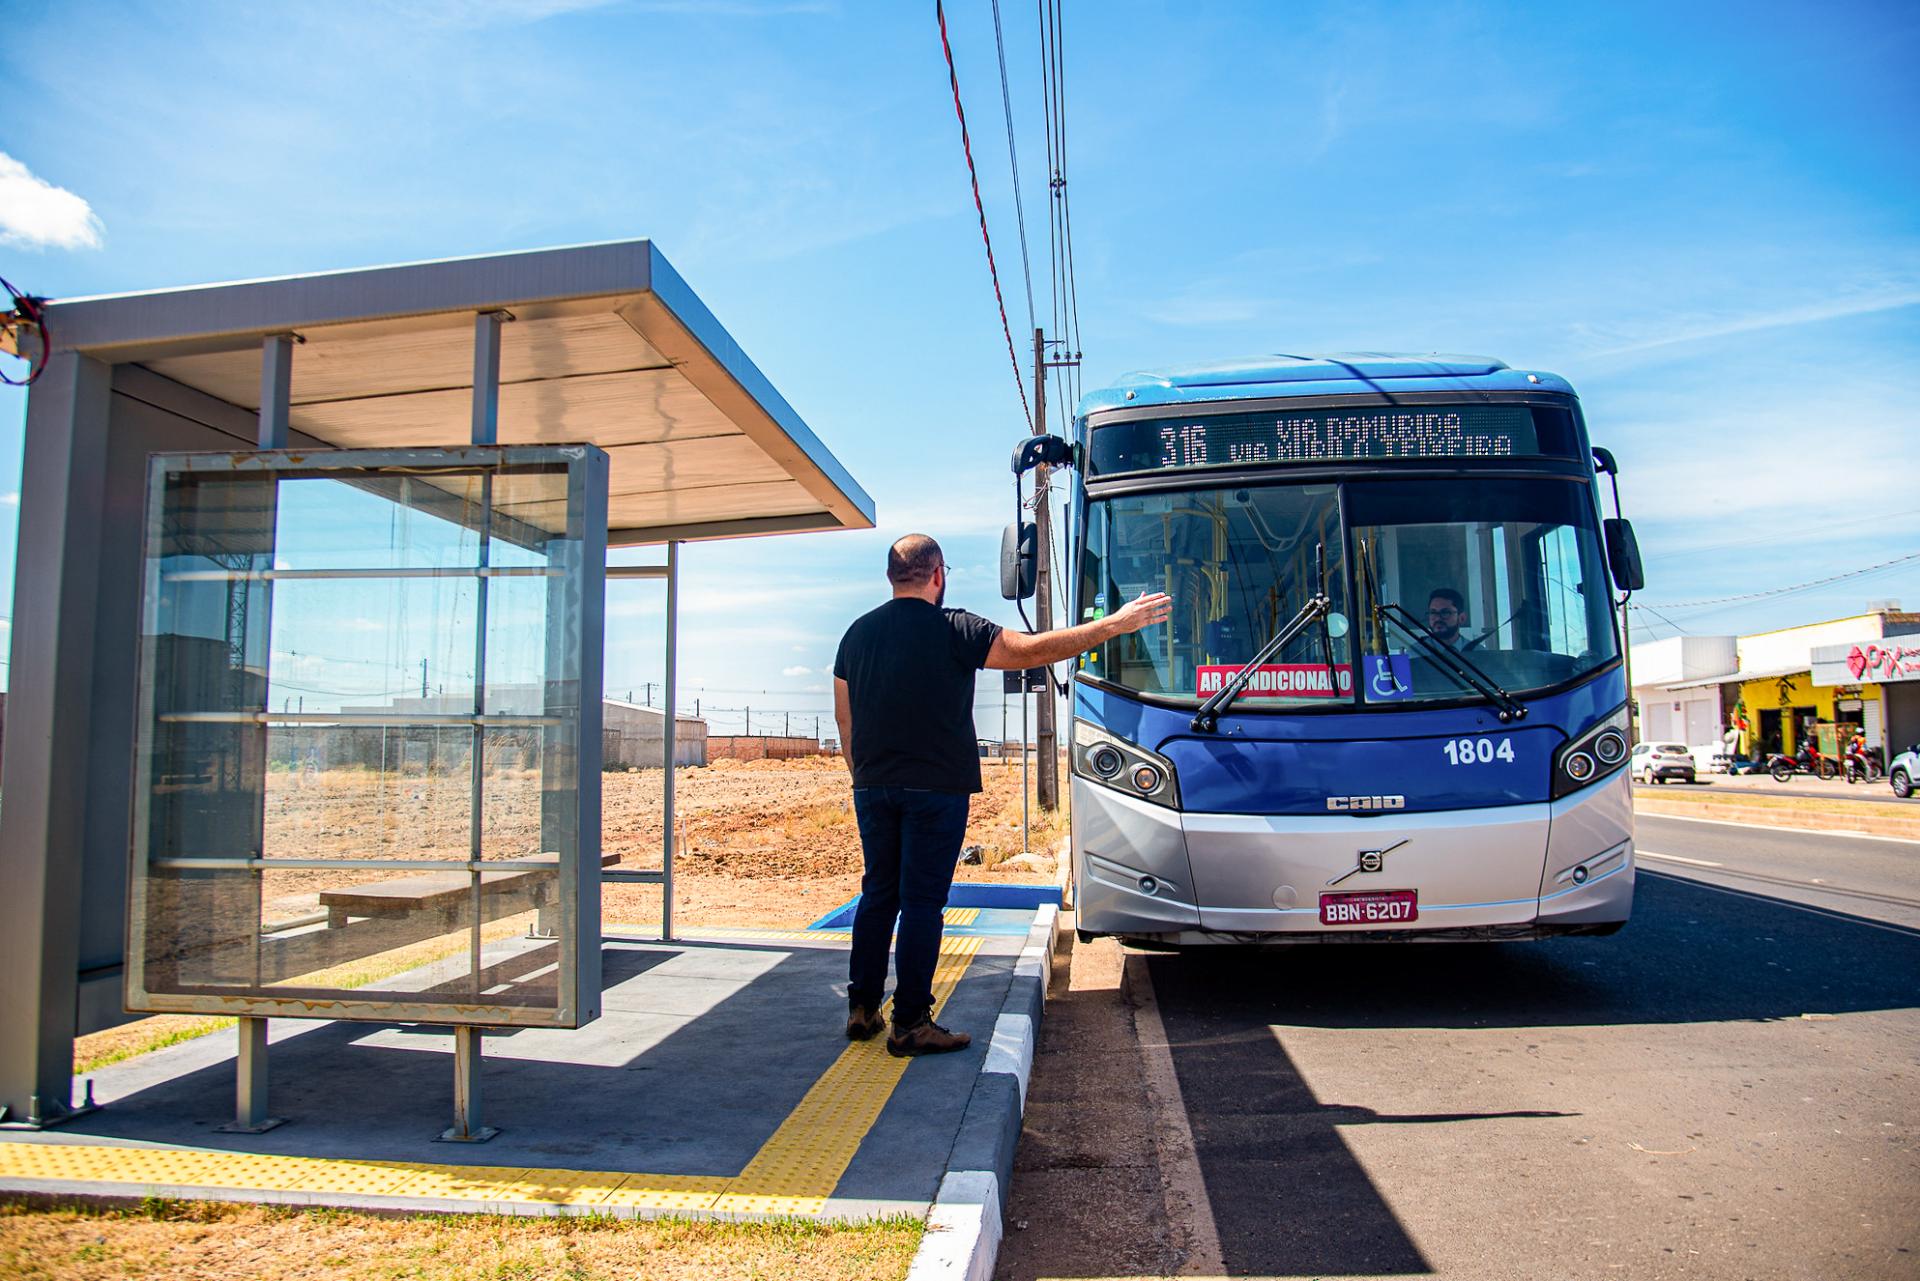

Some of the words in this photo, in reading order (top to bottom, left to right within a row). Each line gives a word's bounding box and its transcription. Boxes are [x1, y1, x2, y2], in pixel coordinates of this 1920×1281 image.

[1277, 419, 1317, 442] VIA
[1160, 426, 1207, 467] 316
[1200, 671, 1222, 691] AR
[1443, 738, 1515, 765] 1804
